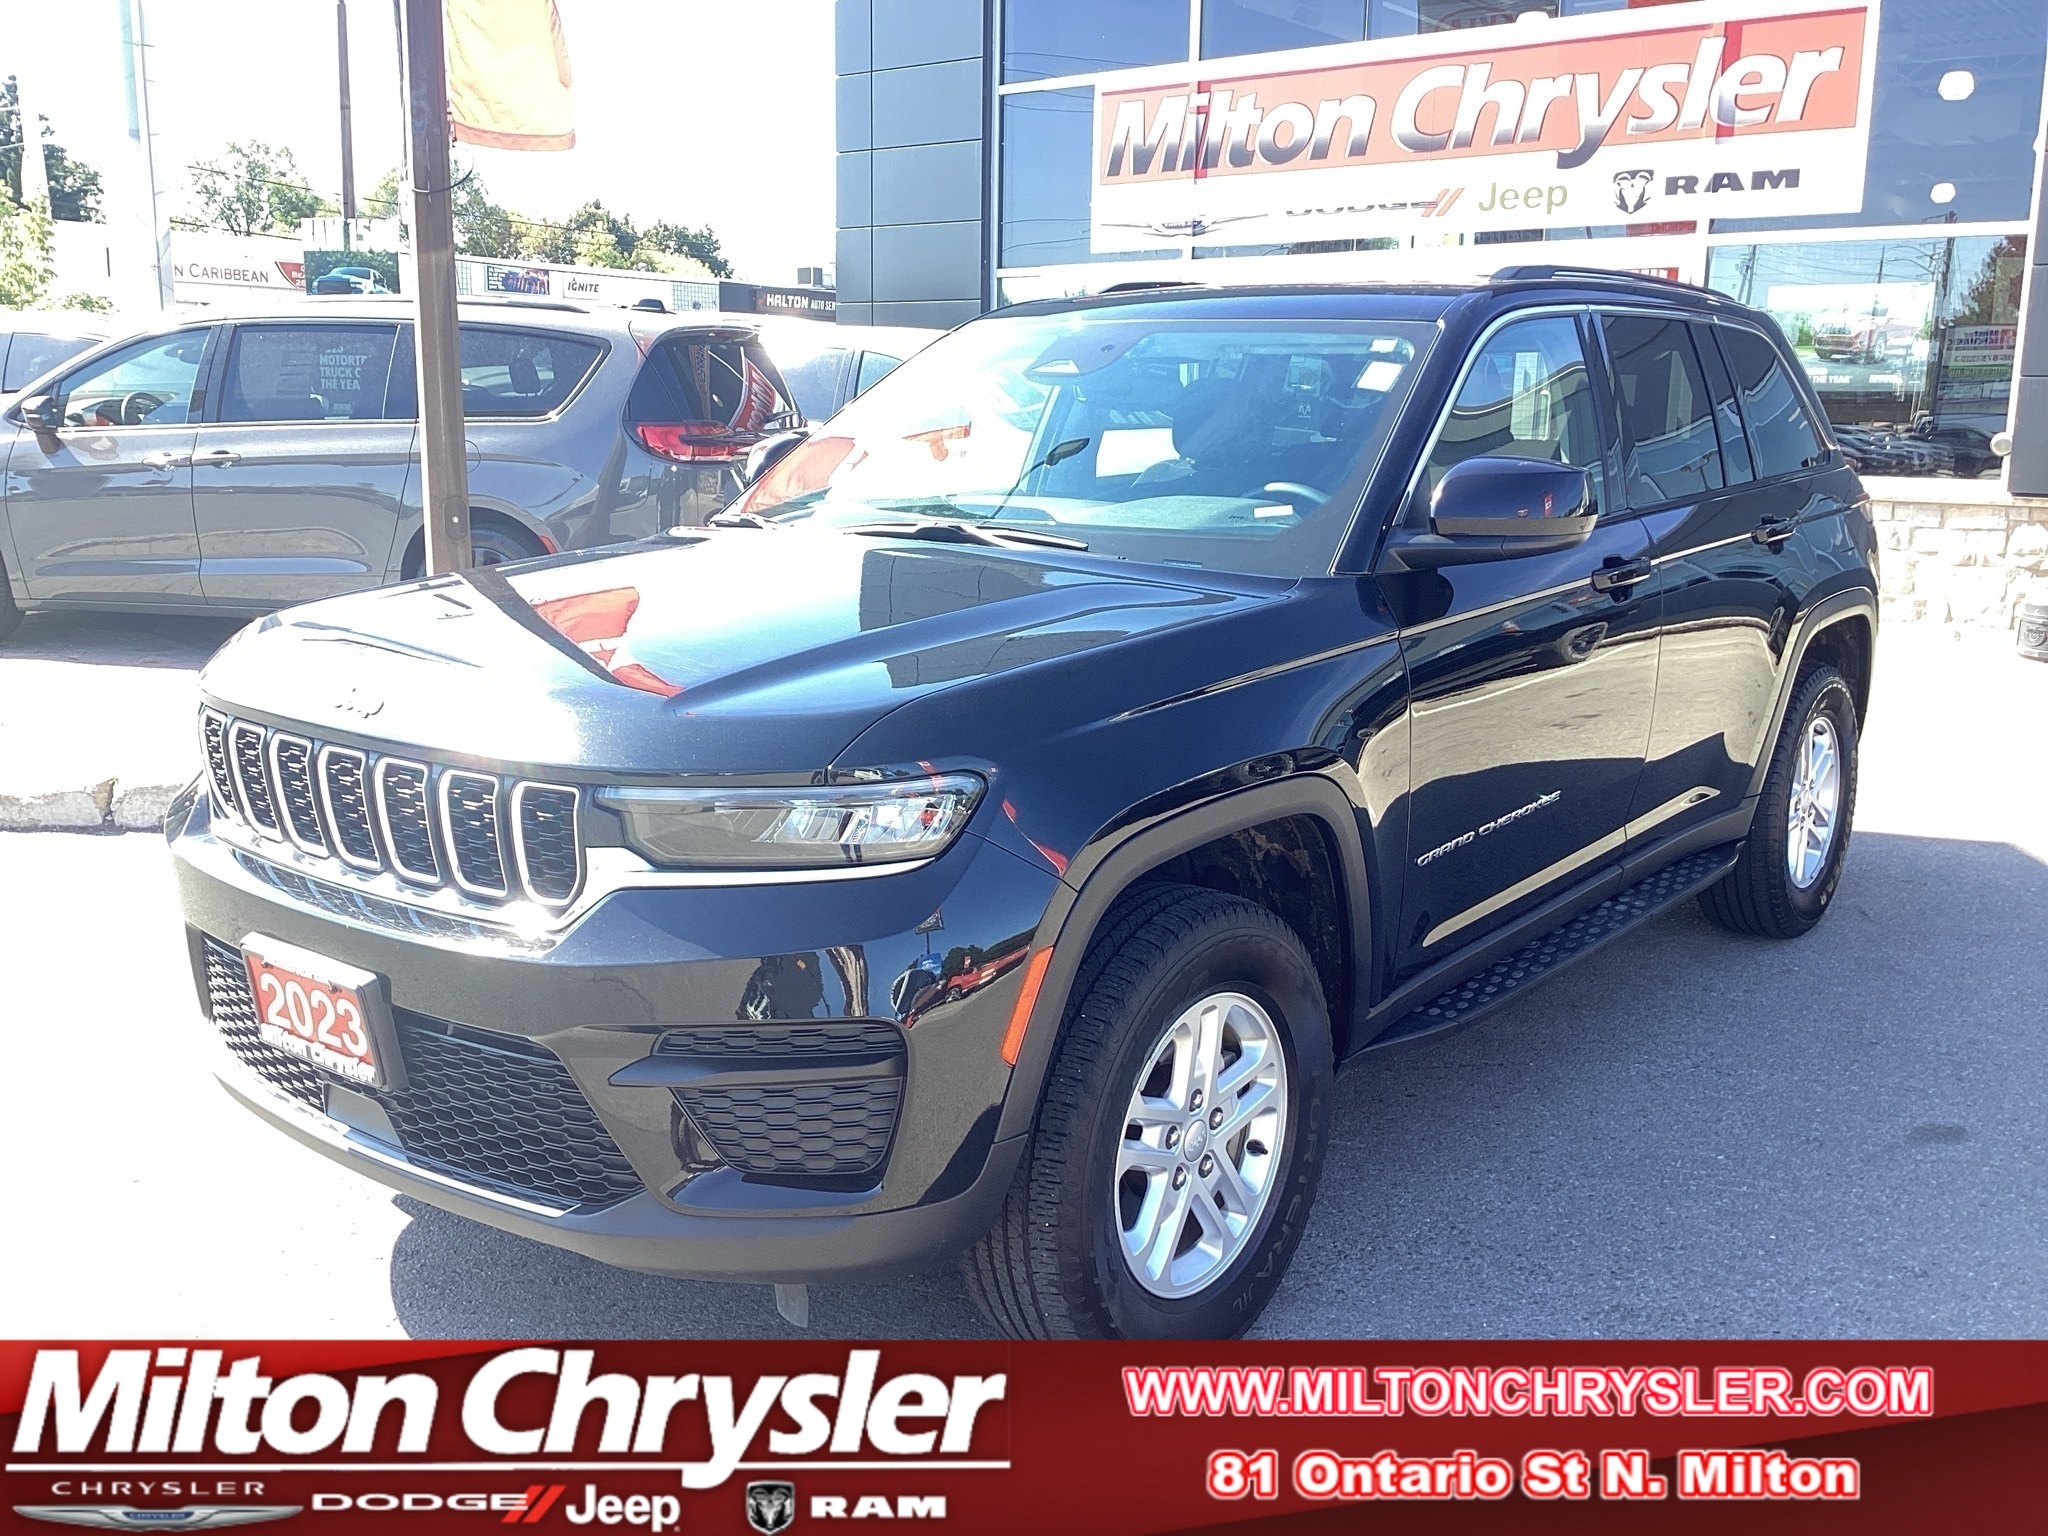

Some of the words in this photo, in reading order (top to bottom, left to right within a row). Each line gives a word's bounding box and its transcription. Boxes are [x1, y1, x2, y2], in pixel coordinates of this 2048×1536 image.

[1105, 86, 1377, 178] Milton
[1391, 35, 1846, 170] Chrysler
[1665, 168, 1801, 196] RAM
[1478, 180, 1569, 216] Jeep
[189, 263, 269, 283] CARIBBEAN
[567, 281, 600, 293] IGNITE
[766, 293, 809, 309] HALTON
[810, 299, 824, 310] AUTO
[320, 366, 353, 378] TRUCK
[320, 379, 338, 390] THE
[1416, 831, 1475, 867] GRAND
[1478, 790, 1562, 837] CHEROKEE
[259, 972, 369, 1057] 2023
